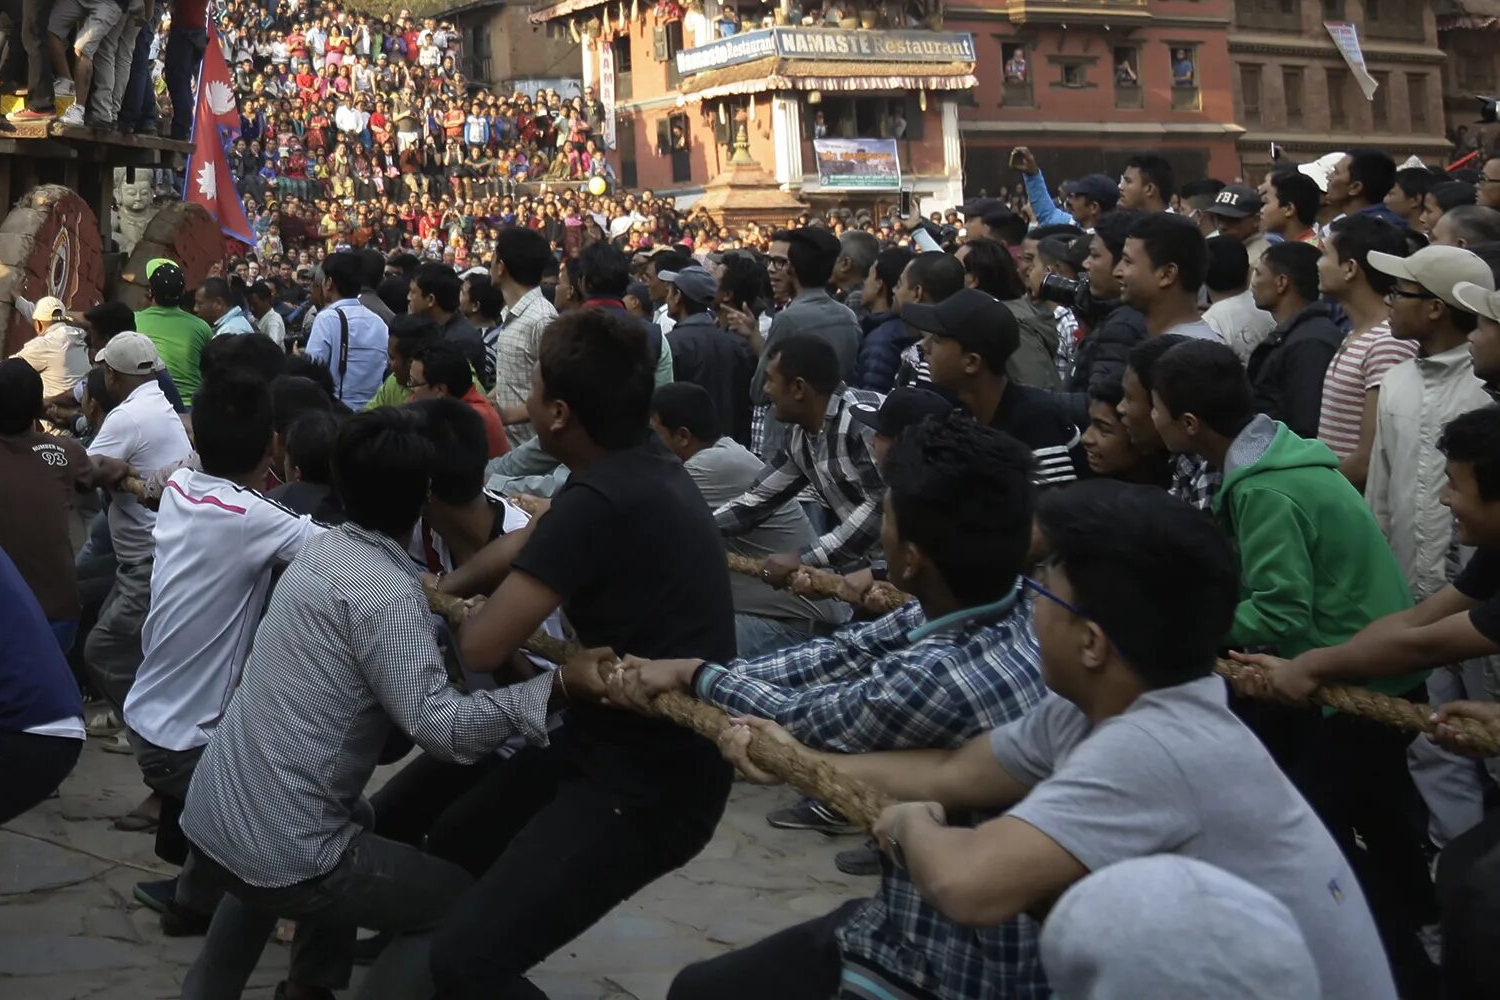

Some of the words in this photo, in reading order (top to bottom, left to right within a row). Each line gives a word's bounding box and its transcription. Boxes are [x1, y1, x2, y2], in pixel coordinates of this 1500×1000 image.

[782, 34, 871, 54] NAMASTE
[874, 35, 970, 56] Restaurant
[676, 44, 728, 74] Namaste
[727, 32, 775, 59] Restaurant
[1215, 191, 1239, 205] FBI
[32, 443, 57, 452] NUMBER
[41, 451, 68, 466] 93
